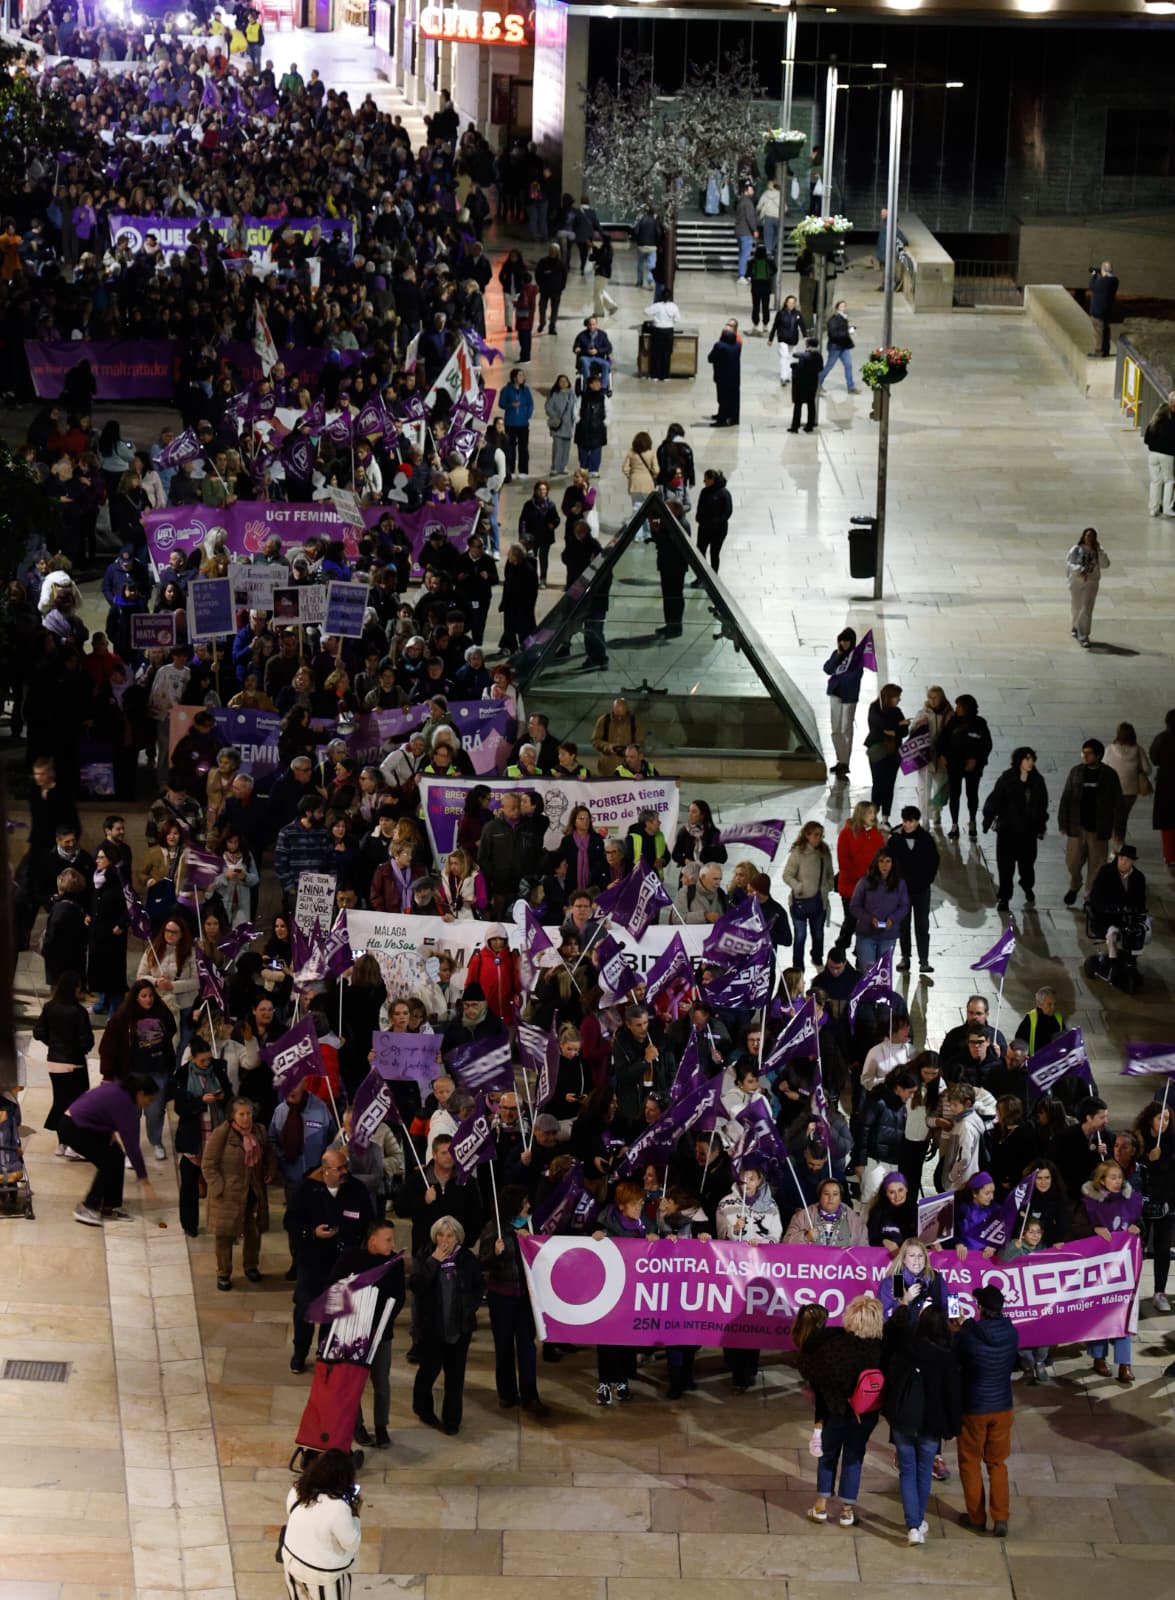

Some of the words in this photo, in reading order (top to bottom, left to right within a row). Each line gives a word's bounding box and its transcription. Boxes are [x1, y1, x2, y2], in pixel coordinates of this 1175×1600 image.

[420, 6, 525, 42] CINES
[266, 510, 290, 522] UGT
[589, 791, 636, 809] POBREZA
[638, 788, 665, 801] tiene
[620, 807, 634, 819] de
[303, 884, 324, 895] NIÑA
[634, 1257, 710, 1274] CONTRA
[714, 1260, 749, 1277] LAS
[753, 1261, 867, 1281] VIOLENCIAS
[1028, 1255, 1130, 1301] CCOO
[634, 1282, 670, 1312] NI
[680, 1281, 733, 1314] UN
[745, 1286, 845, 1319] PASO
[1040, 1305, 1053, 1316] de
[1055, 1304, 1065, 1314] la
[1067, 1301, 1095, 1314] mujer
[1101, 1293, 1132, 1305] Málag
[633, 1317, 661, 1331] 25N
[664, 1320, 680, 1330] DIA
[683, 1320, 772, 1335] INTERNACIONAL
